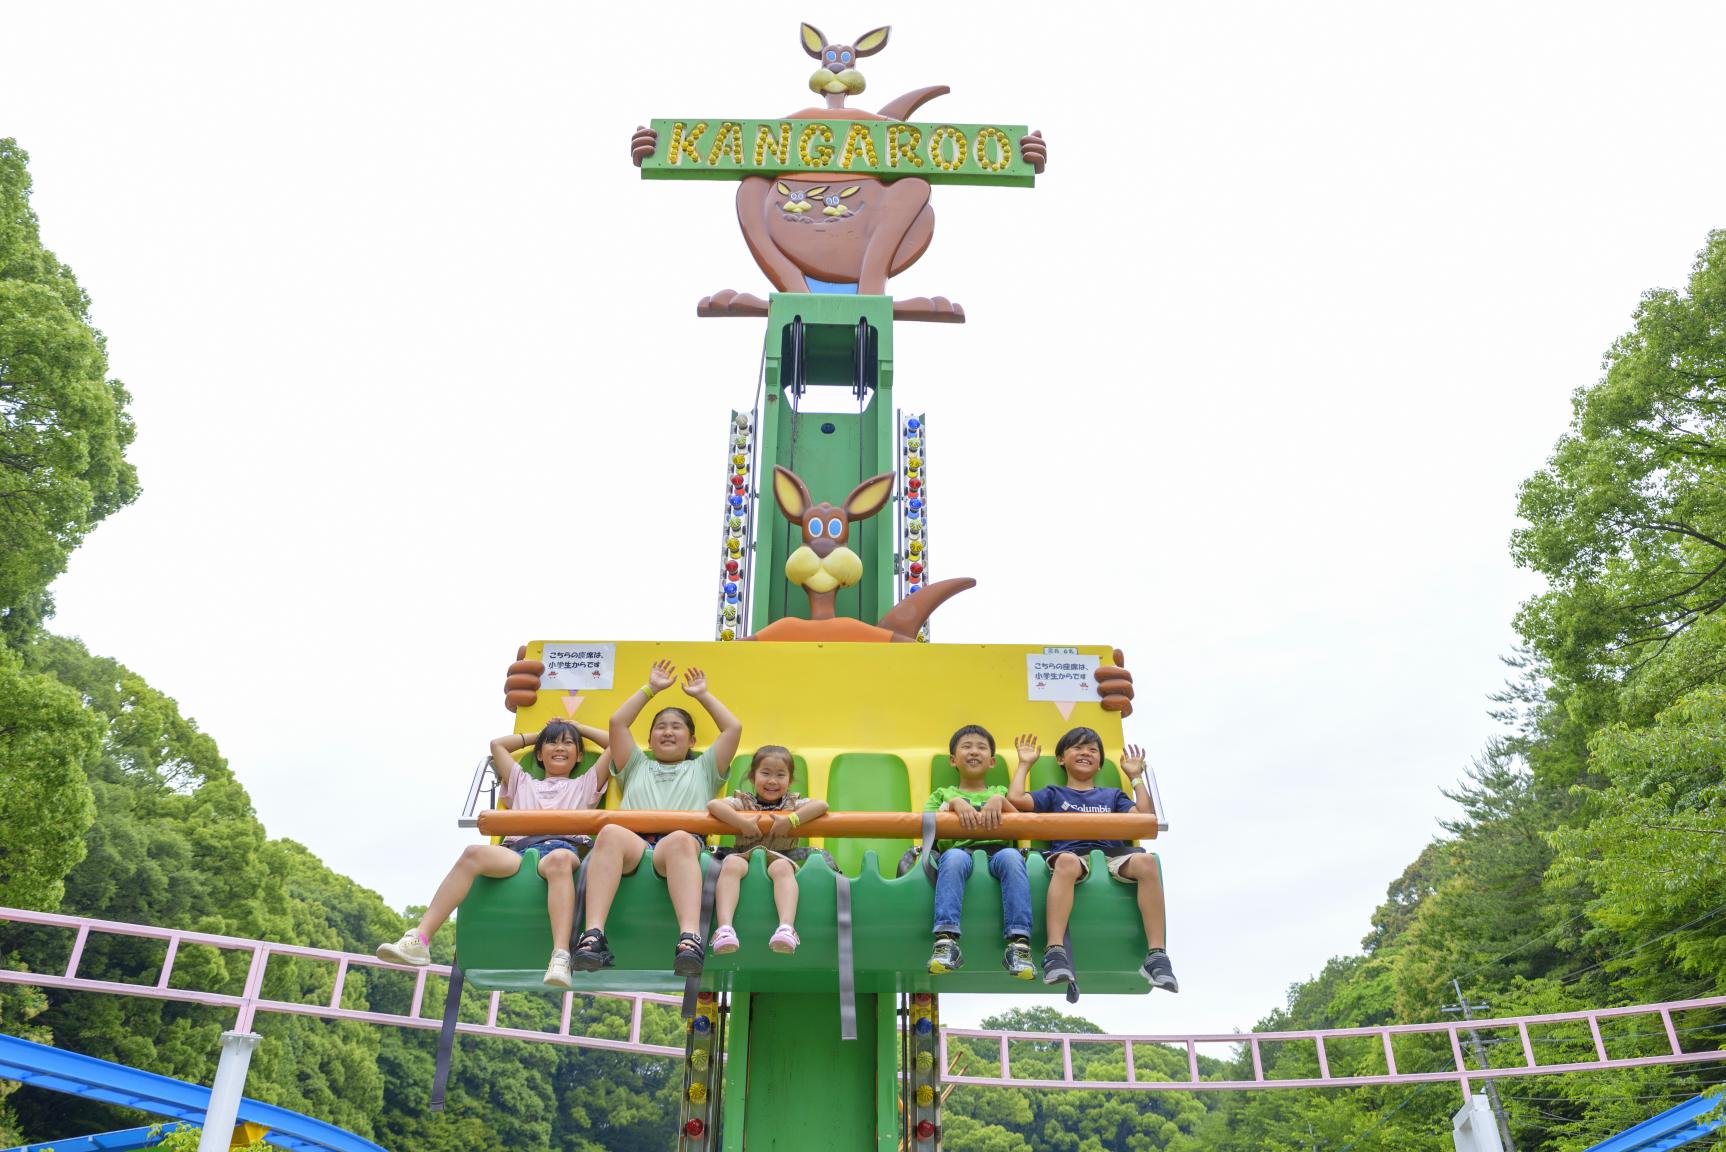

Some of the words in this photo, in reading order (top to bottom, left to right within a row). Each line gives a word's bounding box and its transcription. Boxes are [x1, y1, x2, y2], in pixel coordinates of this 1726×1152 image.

[667, 121, 1013, 172] KANGAROO
[548, 661, 600, 669] 小学生からです
[1035, 672, 1086, 680] 小学生からです
